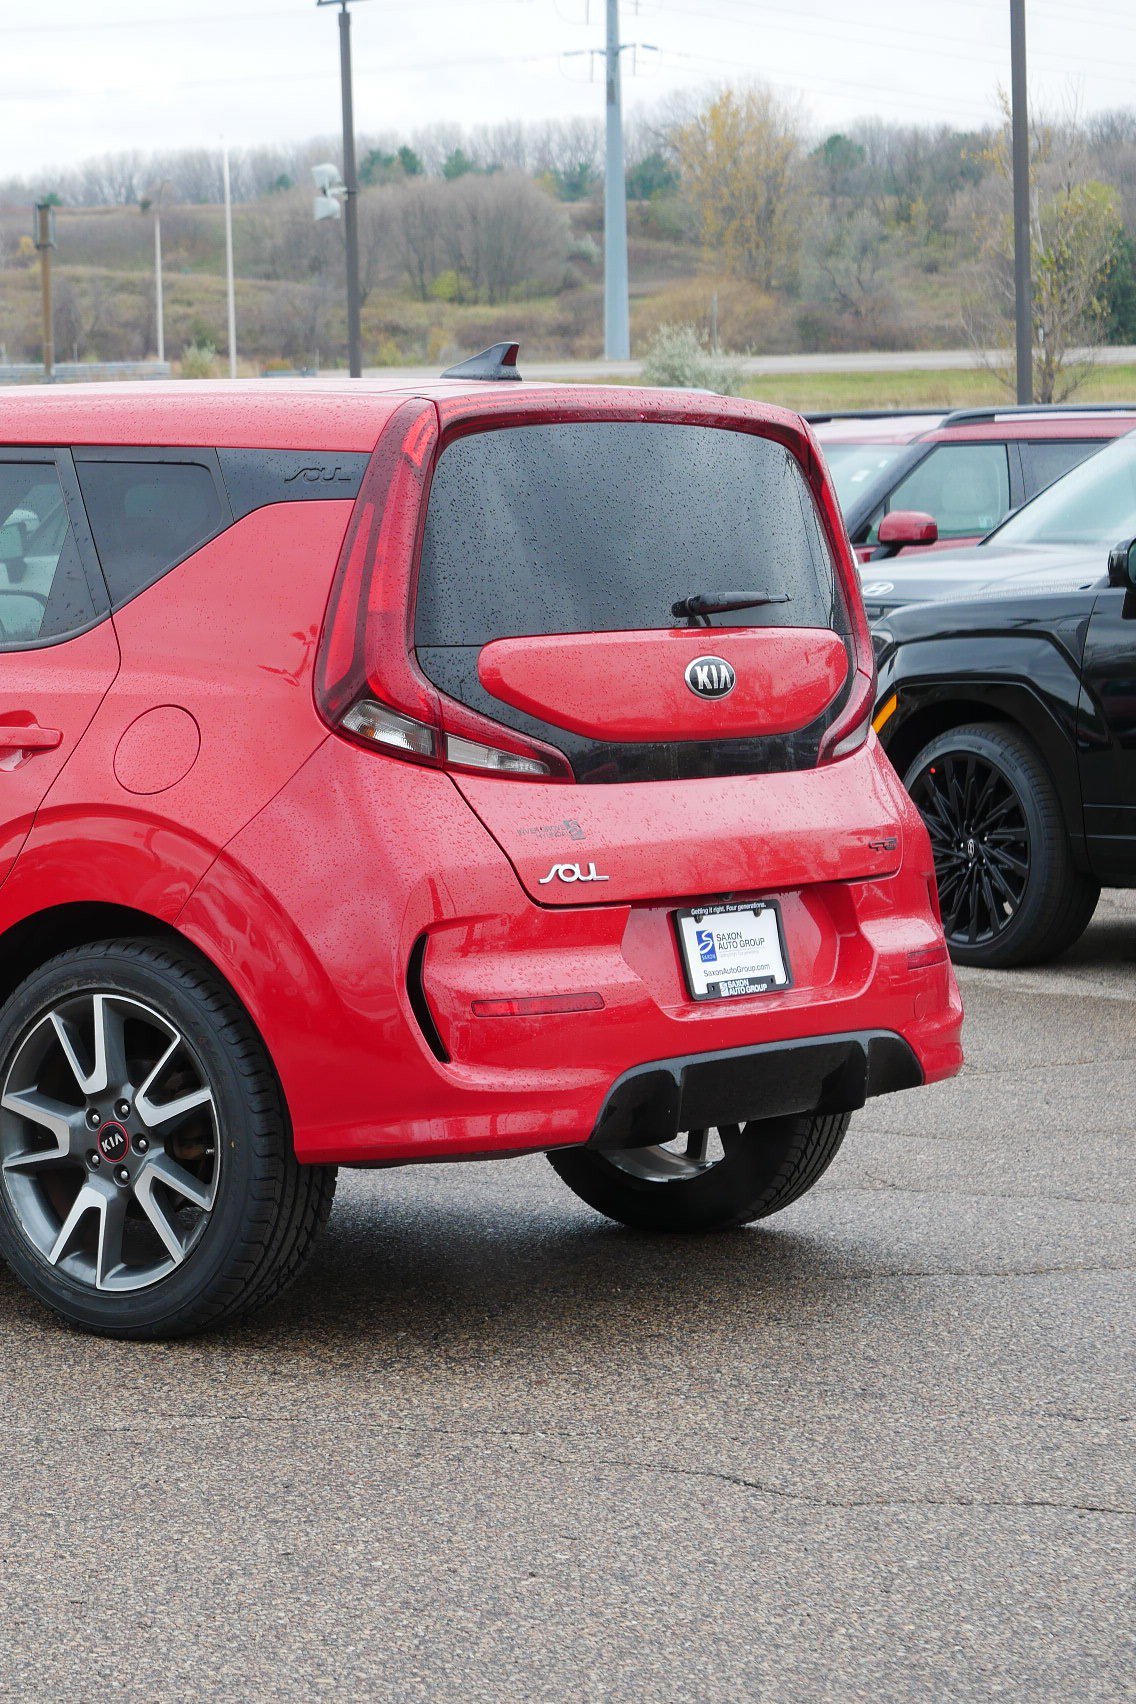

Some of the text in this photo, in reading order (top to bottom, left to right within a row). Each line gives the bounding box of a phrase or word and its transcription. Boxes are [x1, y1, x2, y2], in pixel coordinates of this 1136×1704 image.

[694, 664, 732, 690] KIA
[538, 862, 610, 884] SOUL
[691, 908, 709, 916] Getting
[716, 931, 743, 942] SAXON
[718, 937, 765, 950] AUTO GROUP
[703, 963, 771, 977] SaxonAutoGroup.com
[727, 979, 750, 988] SAXON
[729, 983, 768, 995] AUTO GROUP
[101, 1132, 124, 1153] KIA
